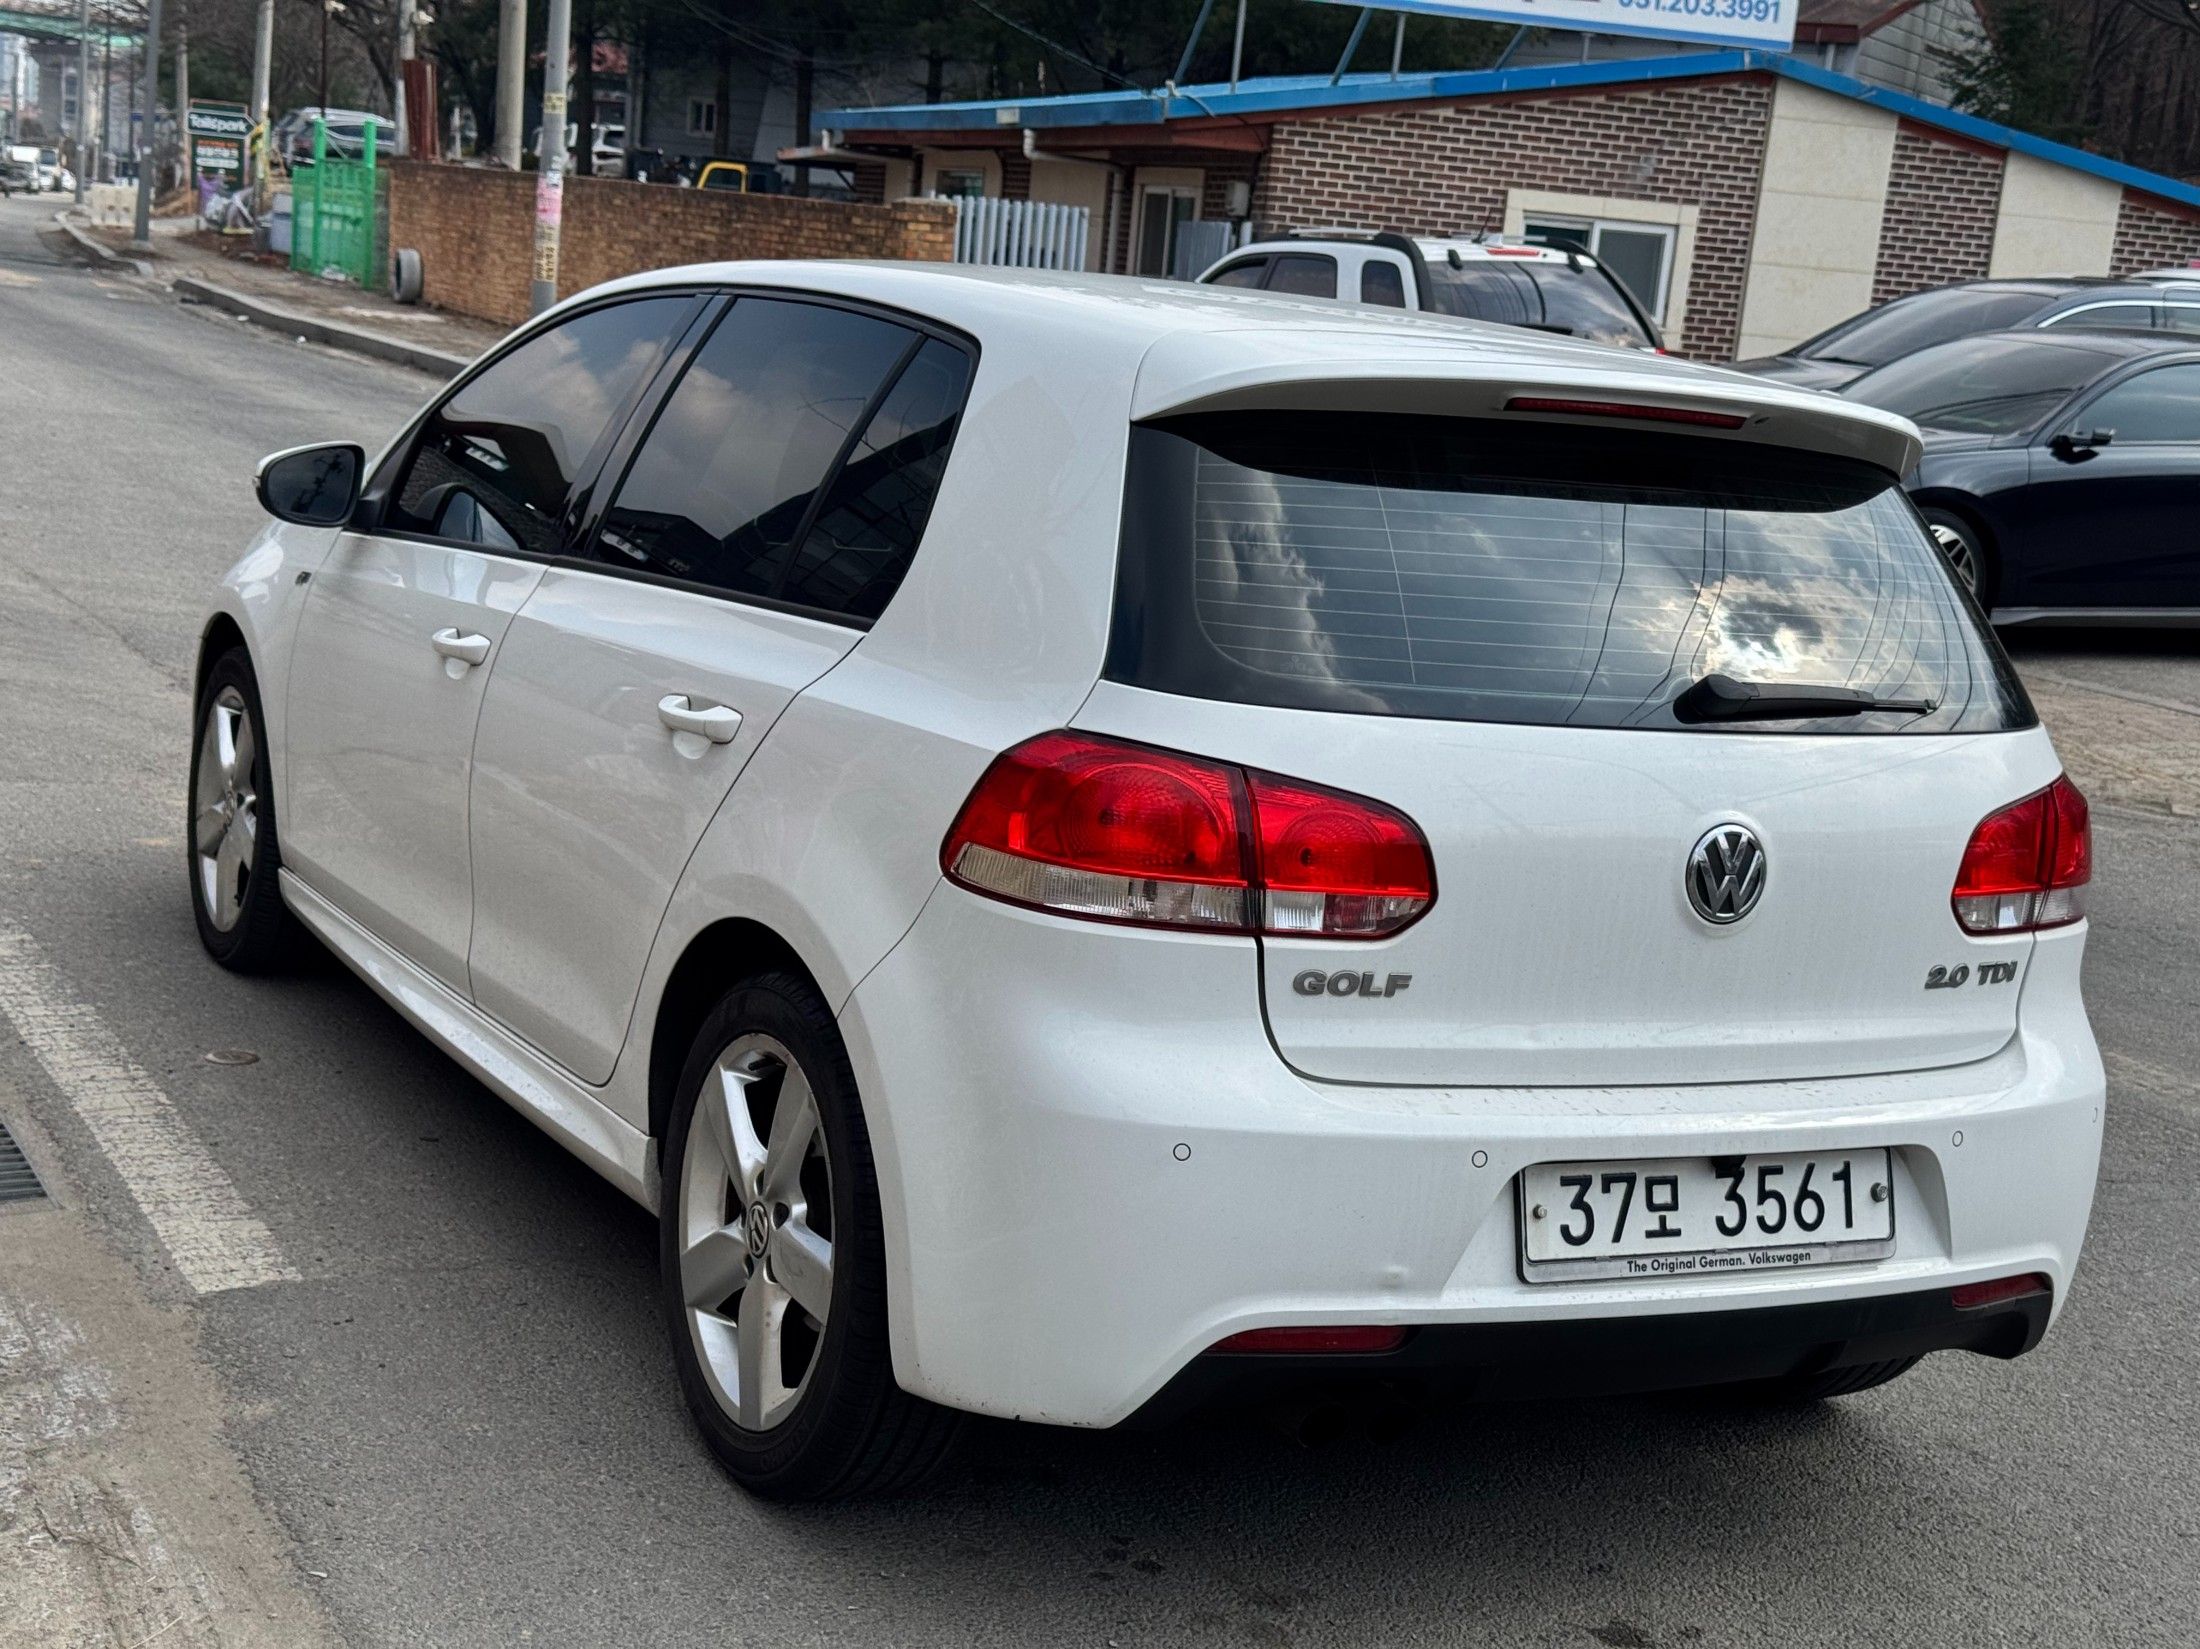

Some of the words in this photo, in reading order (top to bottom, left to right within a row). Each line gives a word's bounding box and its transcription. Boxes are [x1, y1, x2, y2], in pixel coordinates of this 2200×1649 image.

[1292, 968, 1413, 997] GOLF
[1977, 960, 2018, 986] TDI
[1560, 1171, 1682, 1247] 37모
[1714, 1160, 1853, 1237] 3561
[1627, 1259, 1647, 1273] The
[1651, 1256, 1696, 1273] Original
[1749, 1251, 1811, 1265] Volkswagen
